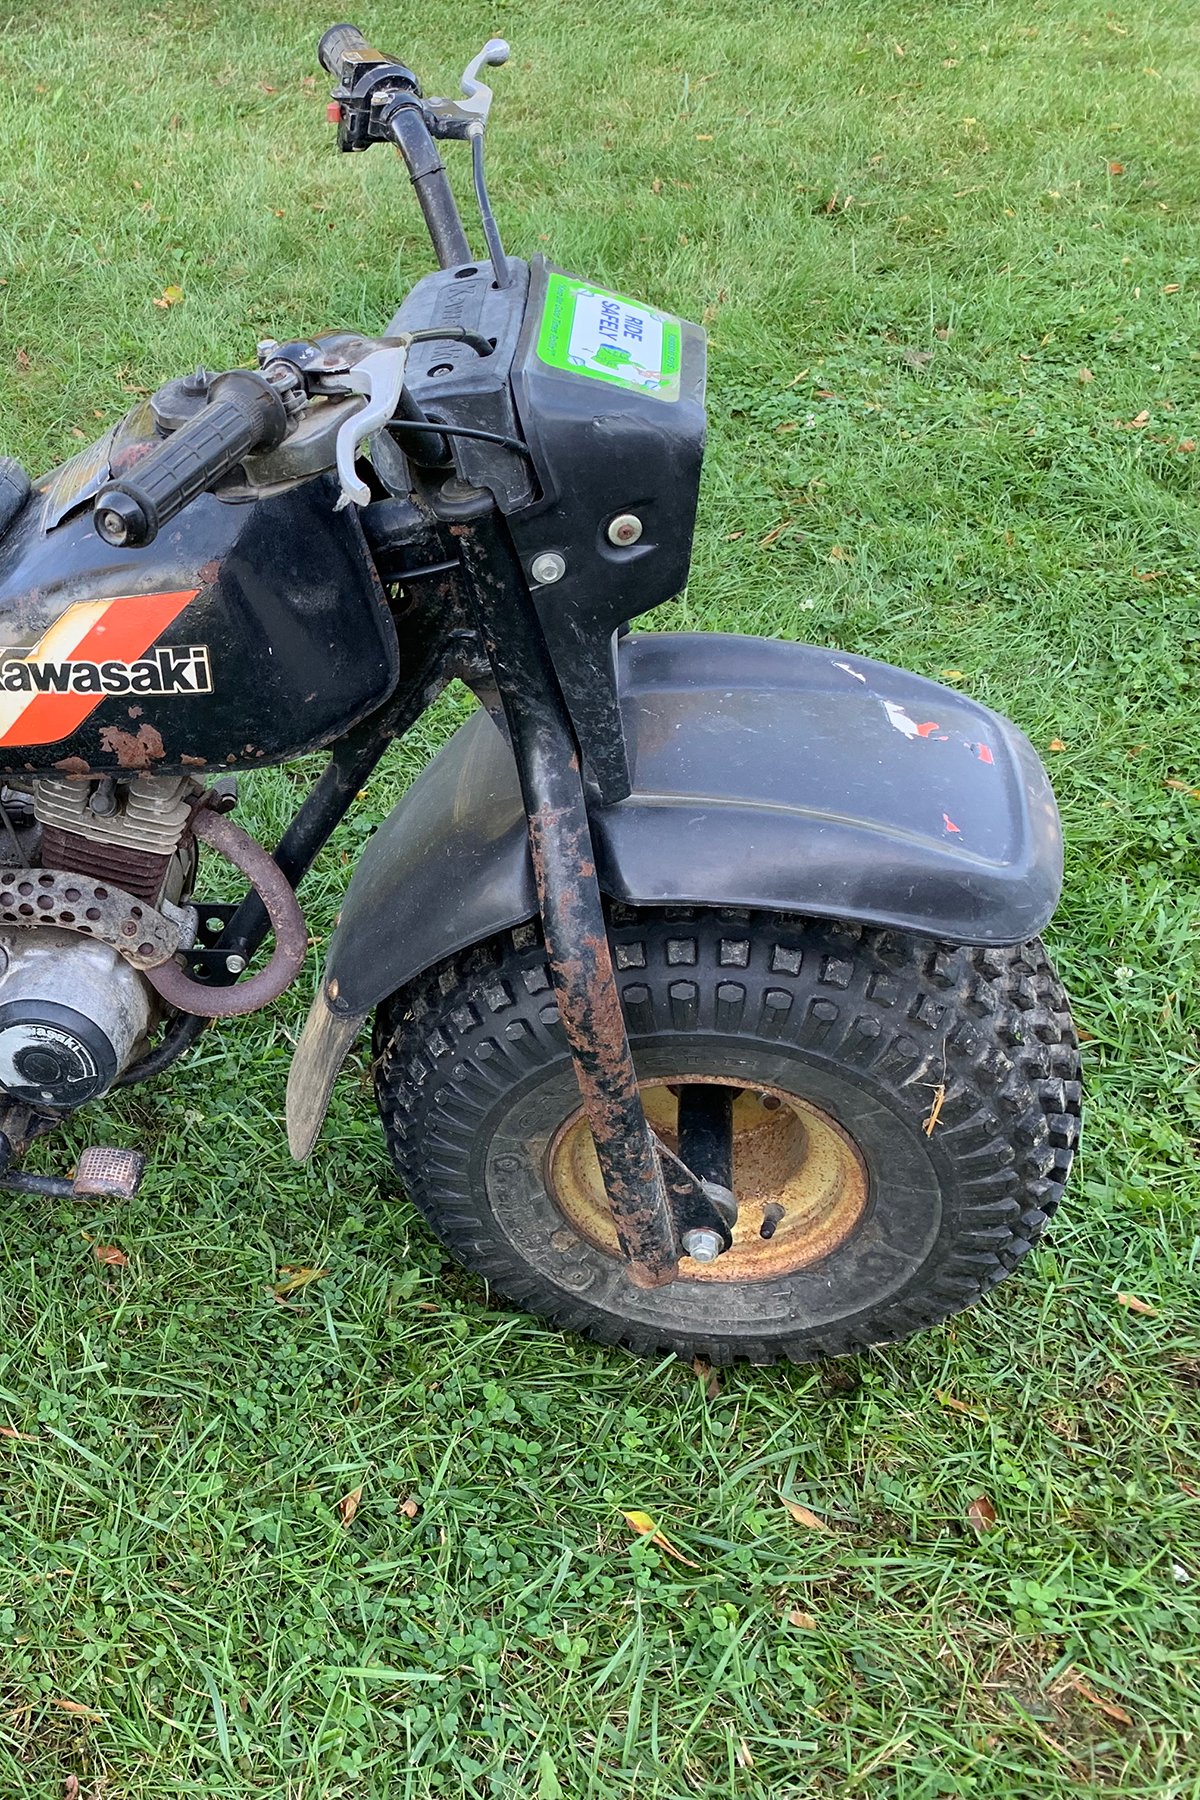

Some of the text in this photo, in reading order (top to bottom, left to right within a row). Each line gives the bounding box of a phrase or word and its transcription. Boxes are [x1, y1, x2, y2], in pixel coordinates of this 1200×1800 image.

[599, 300, 620, 341] SAFELY
[623, 314, 643, 342] RIDE
[31, 1026, 81, 1053] asaki
